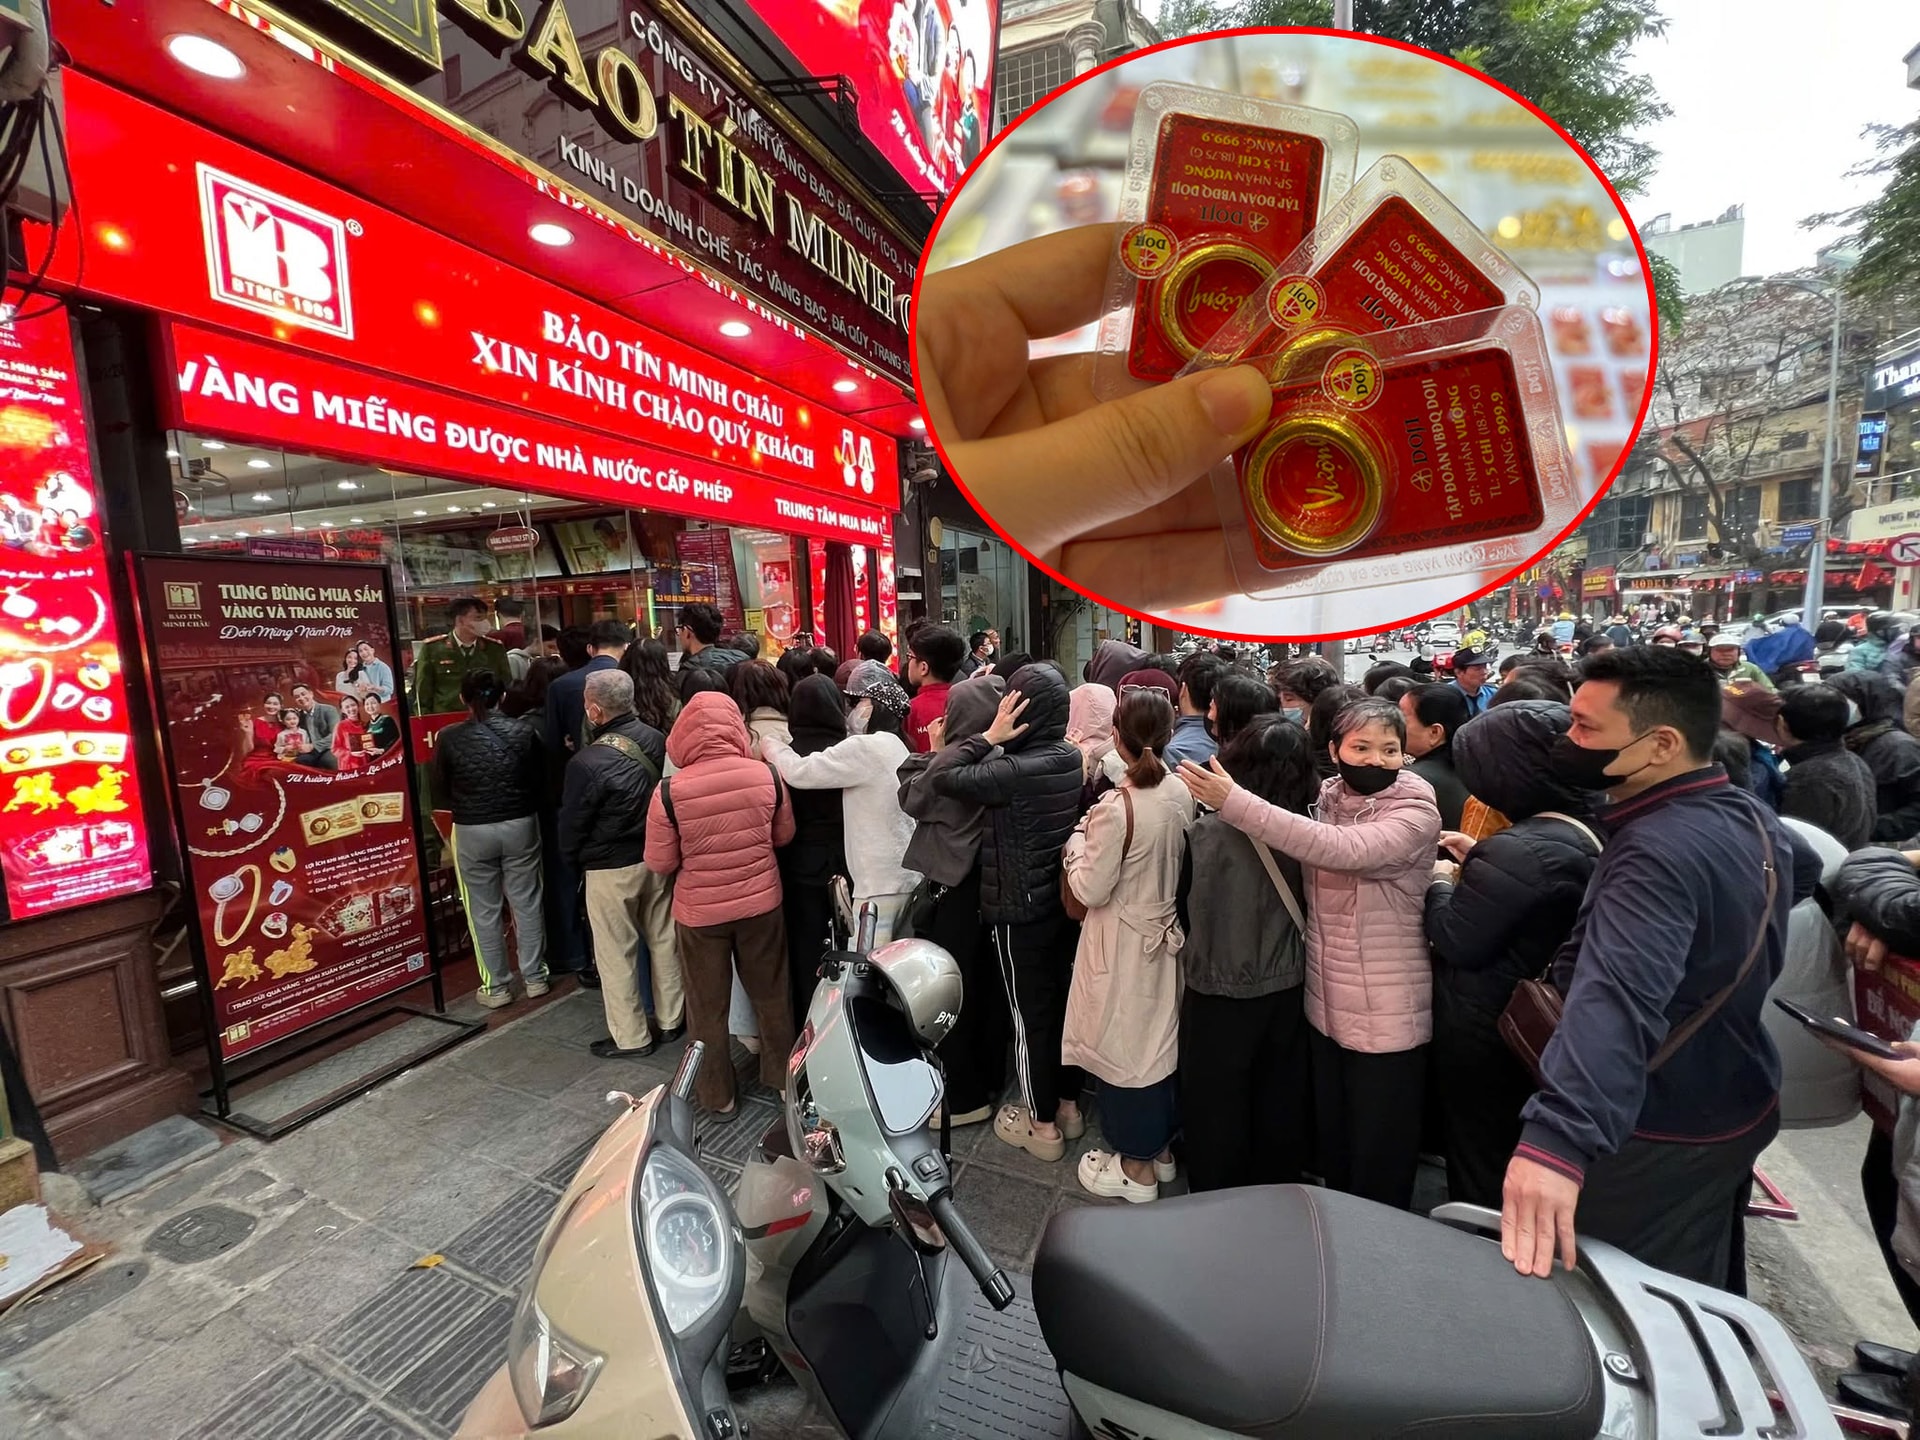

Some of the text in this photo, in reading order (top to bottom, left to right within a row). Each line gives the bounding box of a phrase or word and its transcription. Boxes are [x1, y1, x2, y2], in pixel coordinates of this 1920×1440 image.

[630, 10, 694, 83] CÔNG
[696, 69, 721, 106] TY
[725, 95, 769, 151] TNHH
[770, 134, 807, 184] VÀNG
[810, 172, 835, 208] BẠC
[838, 198, 854, 227] ĐÁ
[855, 215, 878, 246] QUÝ
[1201, 131, 1240, 147] 999.9
[1184, 164, 1233, 181] VƯỢNG
[1263, 158, 1271, 169] 5
[1171, 180, 1200, 198] DOJI
[1274, 177, 1293, 190] SP:
[669, 92, 776, 236] TÍN
[785, 189, 897, 326] MINH
[1239, 191, 1276, 208] ĐOÀN
[1276, 195, 1300, 213] TẬP
[1201, 203, 1243, 225] DOJI
[560, 135, 617, 193] KINH
[622, 176, 694, 241] DOANH
[696, 235, 732, 264] CHẾ
[734, 249, 764, 283] TÁC
[766, 269, 801, 305] VÀNG
[831, 315, 847, 337] ĐÁ
[872, 340, 902, 369] TRANG
[1407, 234, 1439, 263] 999.9
[1352, 258, 1378, 284] DOJI
[1373, 250, 1412, 289] VƯỢNG
[231, 277, 286, 306] BTMC
[1287, 285, 1317, 311] DOJI
[1440, 289, 1451, 300] 5
[1358, 294, 1399, 330] DOJI
[542, 310, 784, 428] BẢO TÍN MINH CHÂU
[1352, 361, 1370, 397] DOJI
[470, 330, 815, 469] XIN KÍNH CHÀO QUÝ KHÁCH
[1468, 384, 1481, 400] G)
[1446, 384, 1468, 440] VƯỢNG
[178, 355, 733, 504] VÀNG MIẾNG ĐƯỢC NHÀ NƯỚC CẤP PHÉP
[1404, 416, 1428, 465] DOJI
[1490, 391, 1521, 486] VÀNG: 999.9
[1421, 378, 1465, 521] TẬP ĐOÀN VBĐQ DOJI
[1475, 438, 1495, 465] CHỈ
[1302, 437, 1345, 511] Vượng
[1485, 467, 1498, 476] 5
[1469, 484, 1483, 506] SP:
[1489, 477, 1502, 499] TL:
[775, 498, 814, 521] TRUNG
[816, 504, 837, 525] TÂM
[839, 514, 859, 533] MUA
[860, 515, 878, 535] BÁN
[319, 588, 352, 602] MUA
[353, 585, 383, 602] SẮM
[221, 603, 360, 619] VÀNG VÀ TRANG SỨC
[219, 625, 253, 640] Đón
[252, 625, 294, 641] Mừng
[294, 625, 326, 638] Năm
[231, 1000, 252, 1010] TRAO
